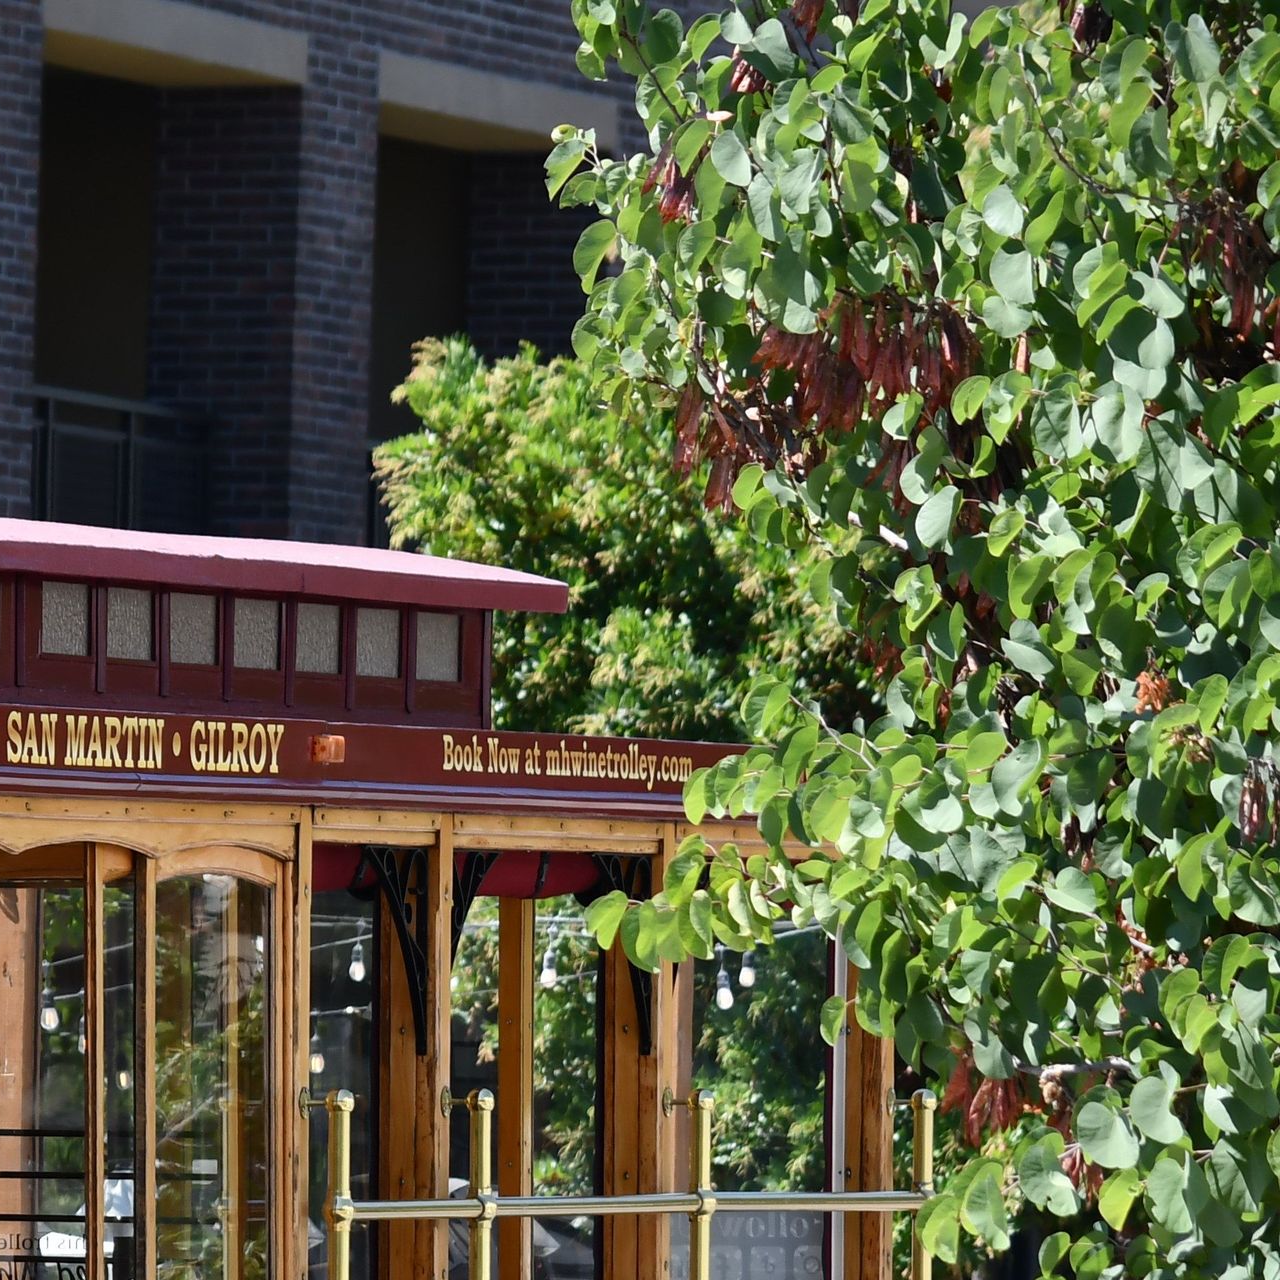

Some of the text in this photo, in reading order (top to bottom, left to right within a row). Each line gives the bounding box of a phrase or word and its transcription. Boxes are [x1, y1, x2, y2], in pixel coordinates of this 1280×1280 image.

[6, 710, 58, 766] SAN
[64, 714, 165, 769] MARTIN
[190, 720, 285, 774] GILROY
[442, 733, 693, 792] Book Now at mhwinetrolley.com
